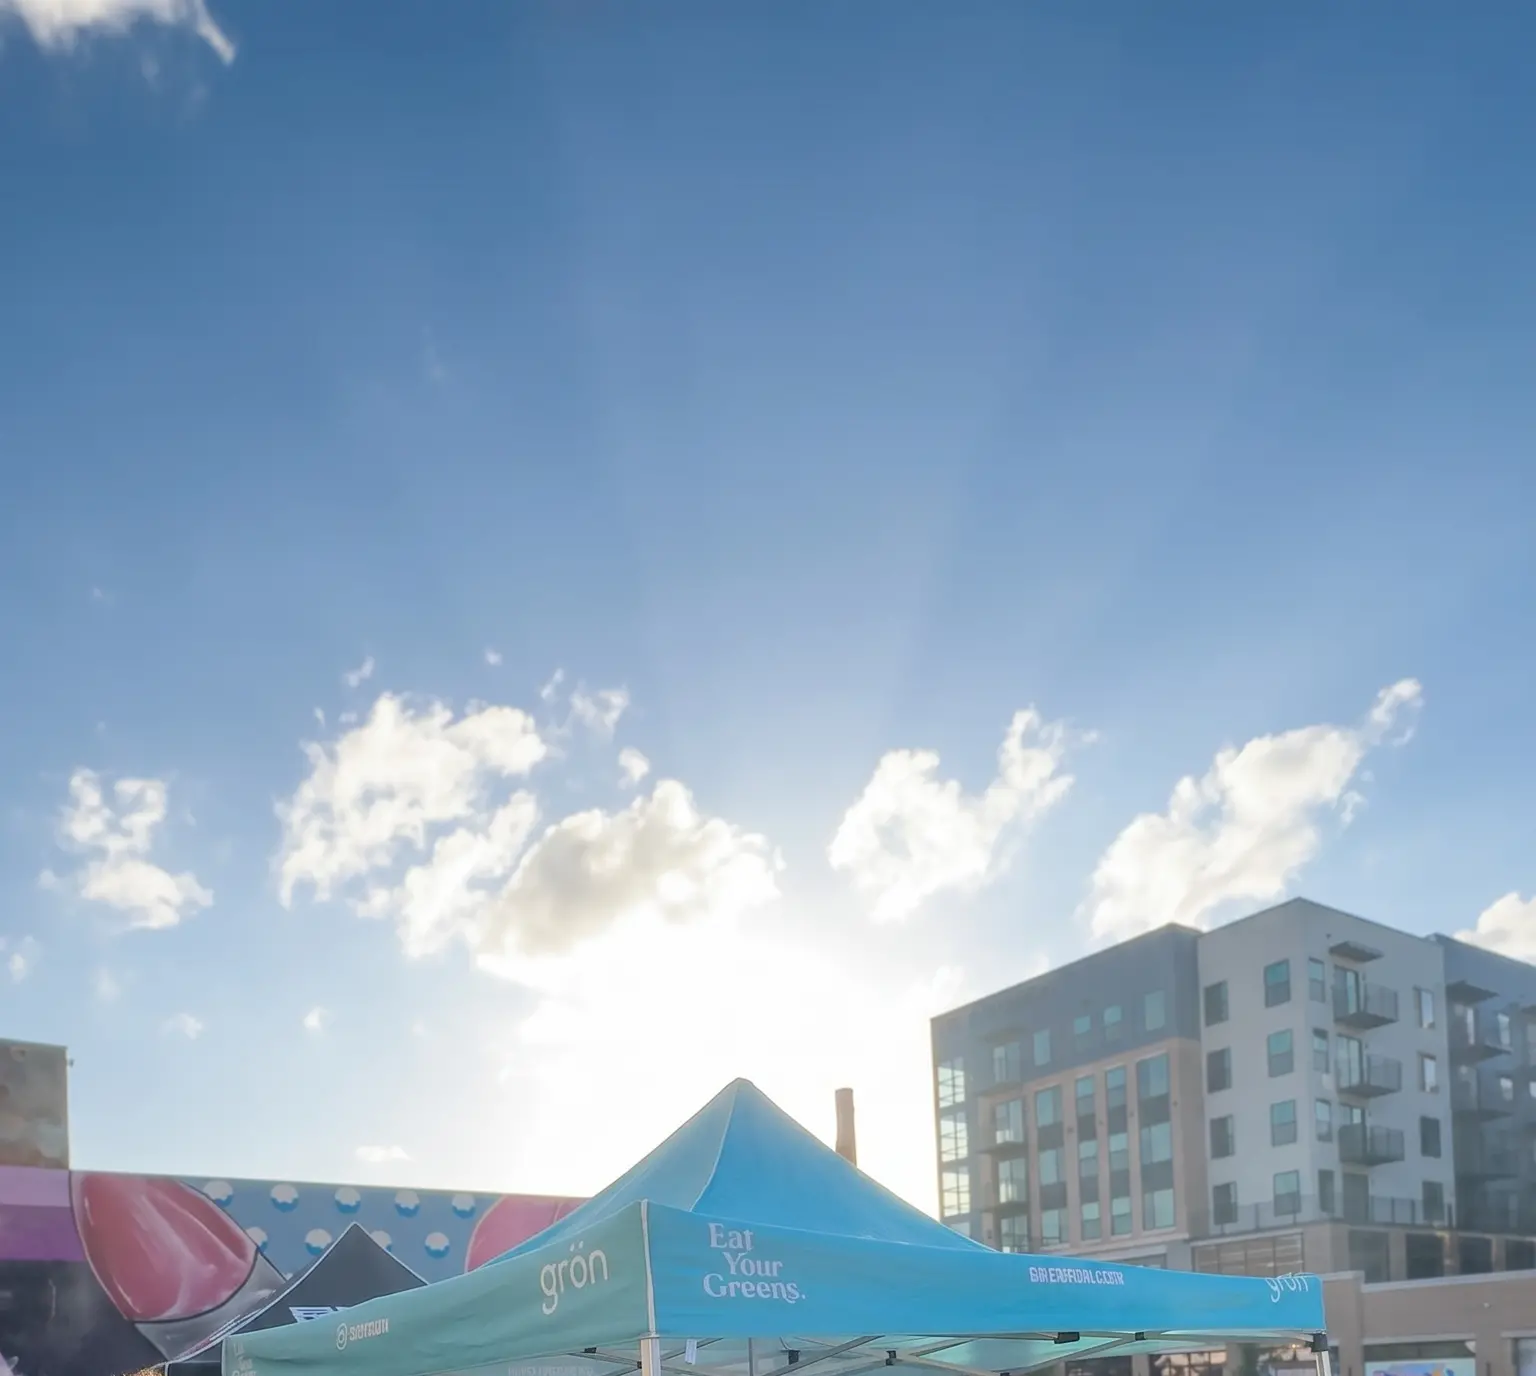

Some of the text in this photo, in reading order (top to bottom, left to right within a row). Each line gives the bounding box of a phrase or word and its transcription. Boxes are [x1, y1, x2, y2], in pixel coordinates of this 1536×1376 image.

[708, 1222, 754, 1251] Eat
[540, 1241, 608, 1315] grön
[722, 1251, 783, 1277] Your
[703, 1273, 806, 1304] Greens.
